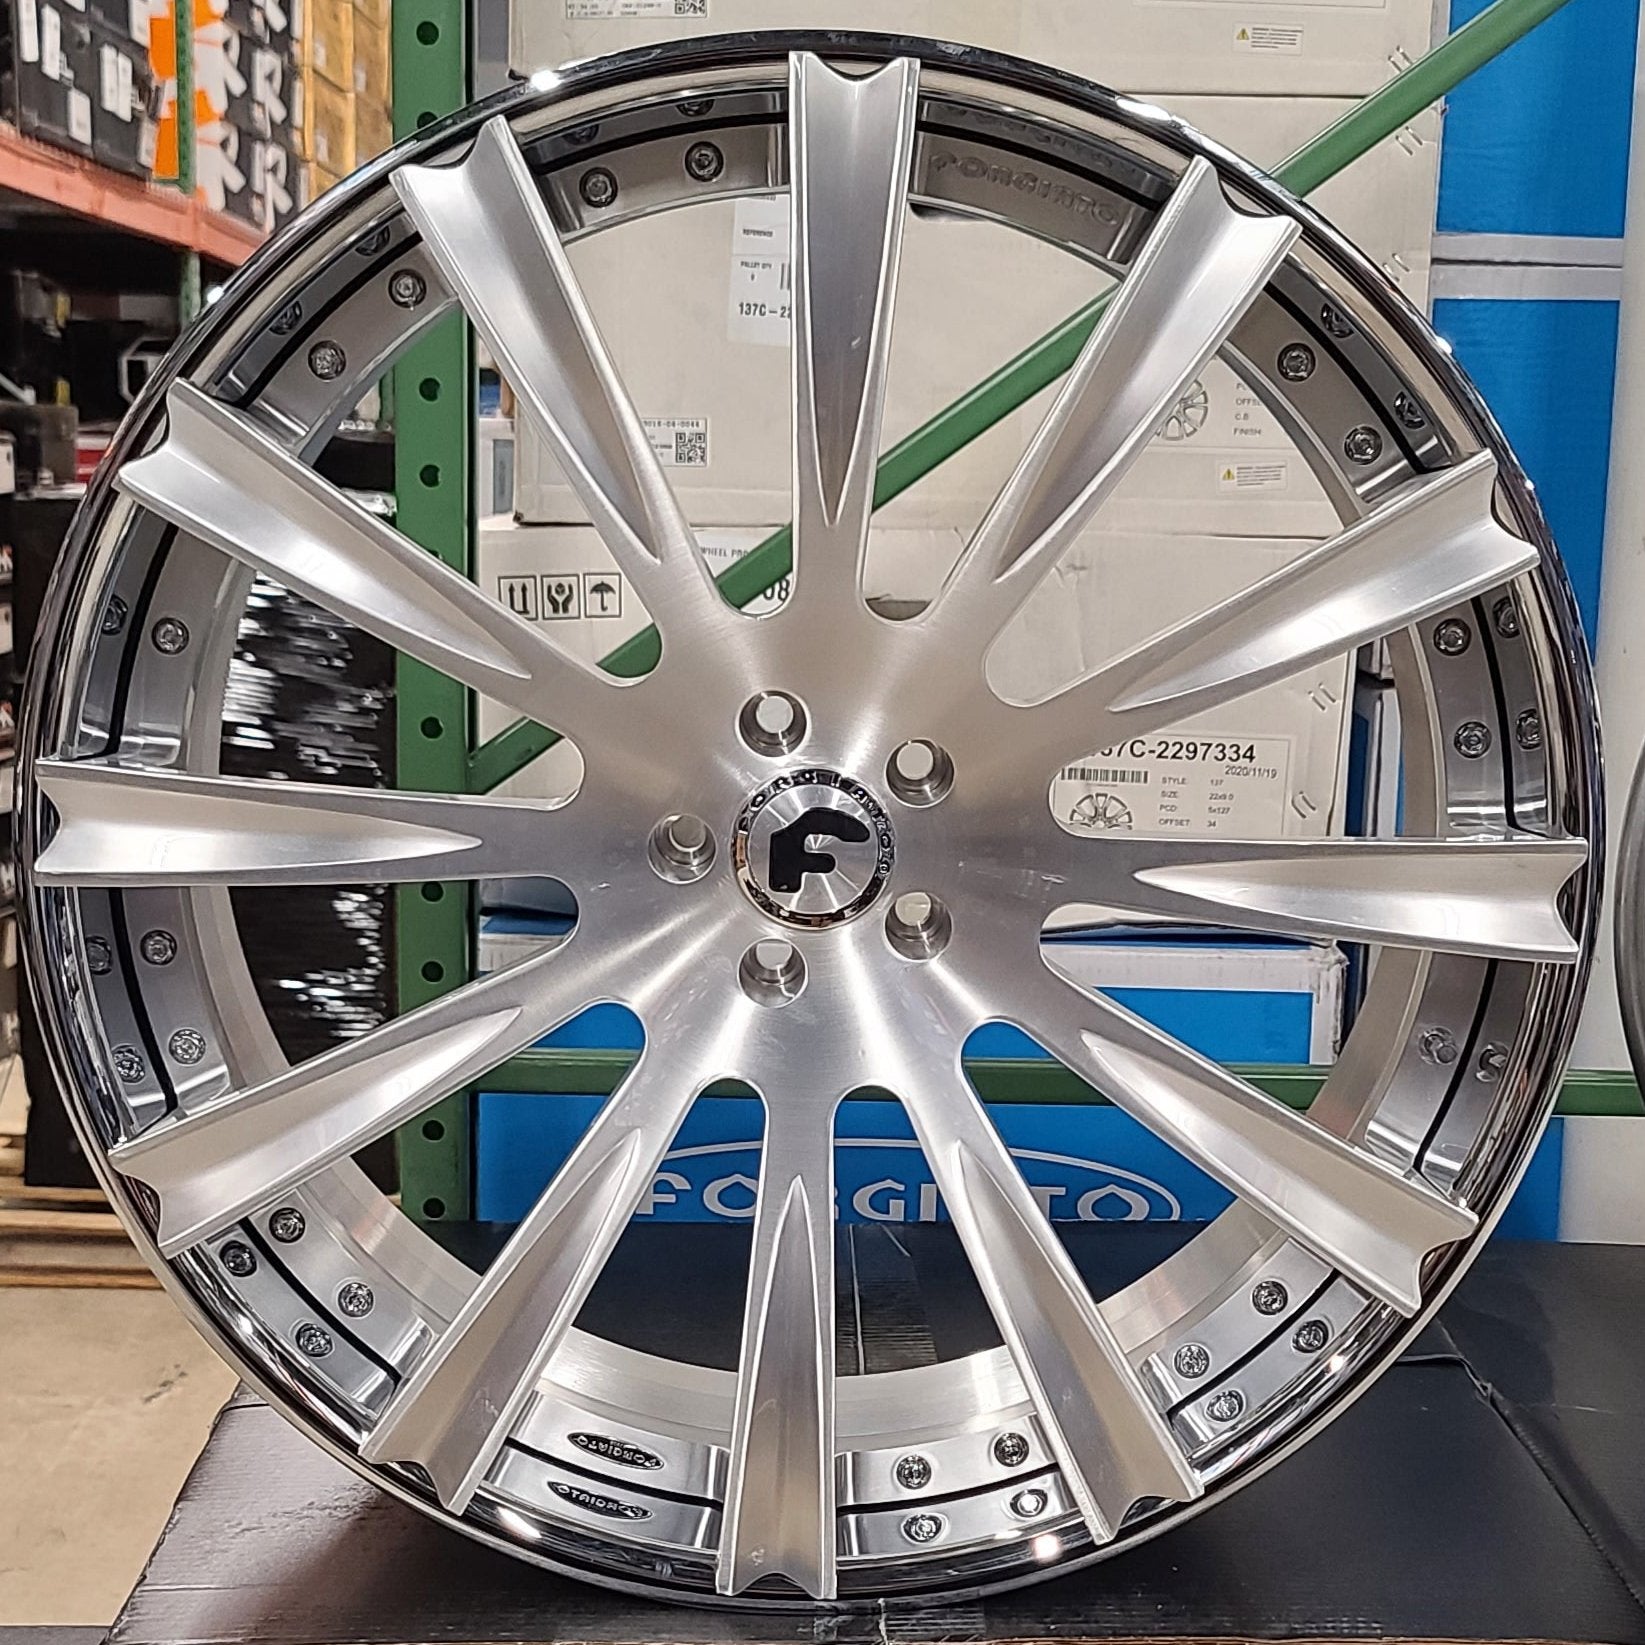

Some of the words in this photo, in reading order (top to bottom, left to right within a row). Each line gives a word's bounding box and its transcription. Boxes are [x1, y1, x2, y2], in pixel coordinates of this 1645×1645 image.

[1225, 764, 1278, 780] 2020/11/19
[1158, 818, 1190, 828] OFFSET
[636, 1171, 1150, 1222] FOGITO
